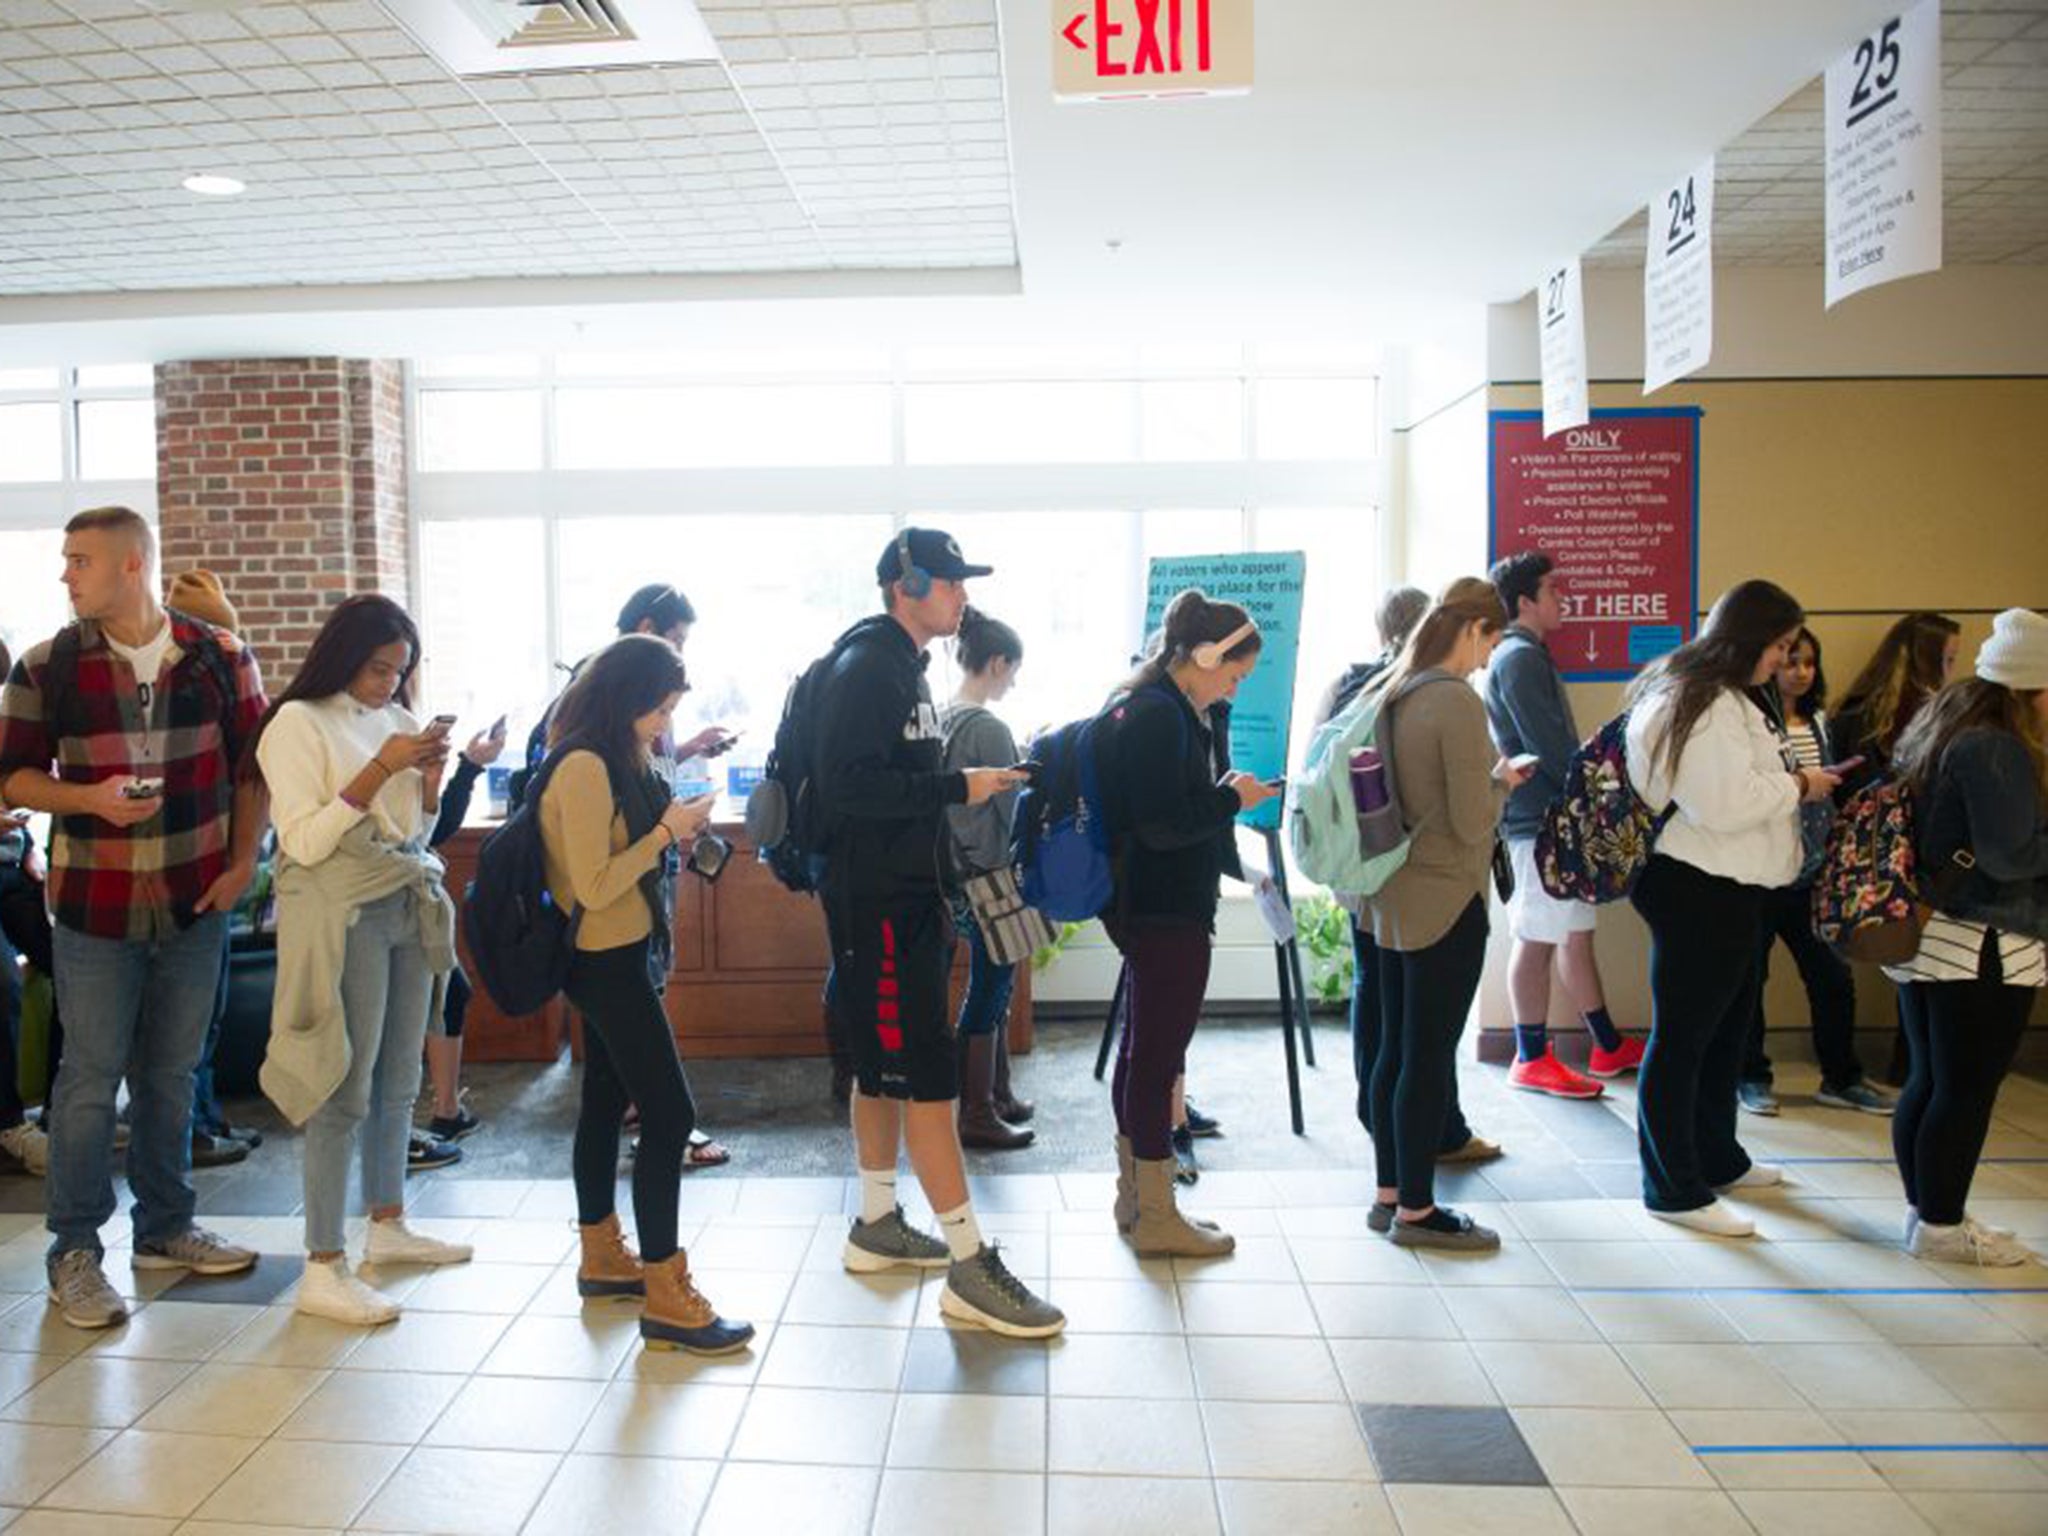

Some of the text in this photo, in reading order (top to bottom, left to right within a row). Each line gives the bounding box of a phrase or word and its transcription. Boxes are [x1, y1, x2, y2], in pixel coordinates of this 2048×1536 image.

[1850, 16, 1901, 109] 25
[1668, 175, 1696, 242] 24
[1548, 267, 1567, 317] 27
[1566, 430, 1621, 447] ONLY
[1520, 451, 1681, 466] Voters in the process of voting
[1531, 468, 1576, 479] Persons
[1620, 466, 1669, 479] providing
[1547, 481, 1652, 493] assistance to voters
[1533, 493, 1668, 507] Precinct Election Officials
[1563, 509, 1638, 520] Poll Watchers
[1527, 522, 1674, 536] Overseers appointed by the
[1576, 536, 1615, 550] County
[1617, 535, 1647, 547] Court
[1649, 535, 1660, 546] of
[1559, 550, 1607, 561] Common
[1170, 563, 1207, 577] voters
[1211, 561, 1238, 574] who
[1241, 562, 1287, 576] appear
[1549, 563, 1656, 577] onstables & Deputy
[1217, 581, 1254, 596] place
[1257, 579, 1276, 593] for
[1279, 578, 1301, 593] the
[1596, 594, 1667, 615] HERE
